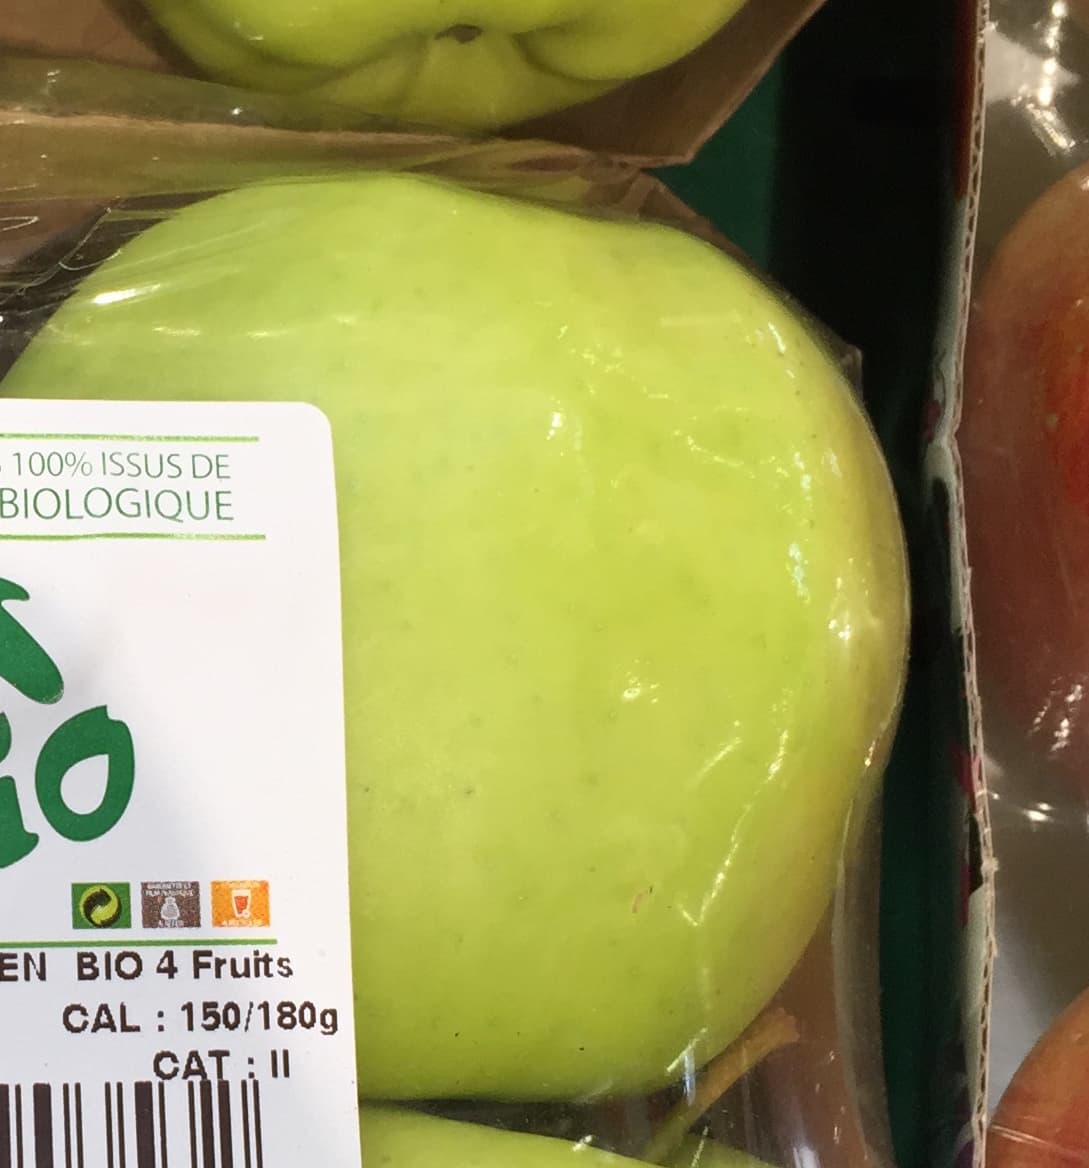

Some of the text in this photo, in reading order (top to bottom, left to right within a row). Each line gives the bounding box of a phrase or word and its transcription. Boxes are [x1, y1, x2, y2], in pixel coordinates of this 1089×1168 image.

[13, 452, 92, 476] 100%
[102, 452, 182, 478] ISSUS
[192, 454, 230, 479] DE
[0, 487, 234, 523] BIOLOGIQUE
[77, 951, 143, 981] BIO
[156, 950, 178, 980] 4
[193, 949, 293, 979] Fruits
[63, 1002, 141, 1034] CAL
[181, 1001, 338, 1035] 150/180g
[153, 1051, 229, 1079] CAT
[270, 1051, 290, 1078] II
